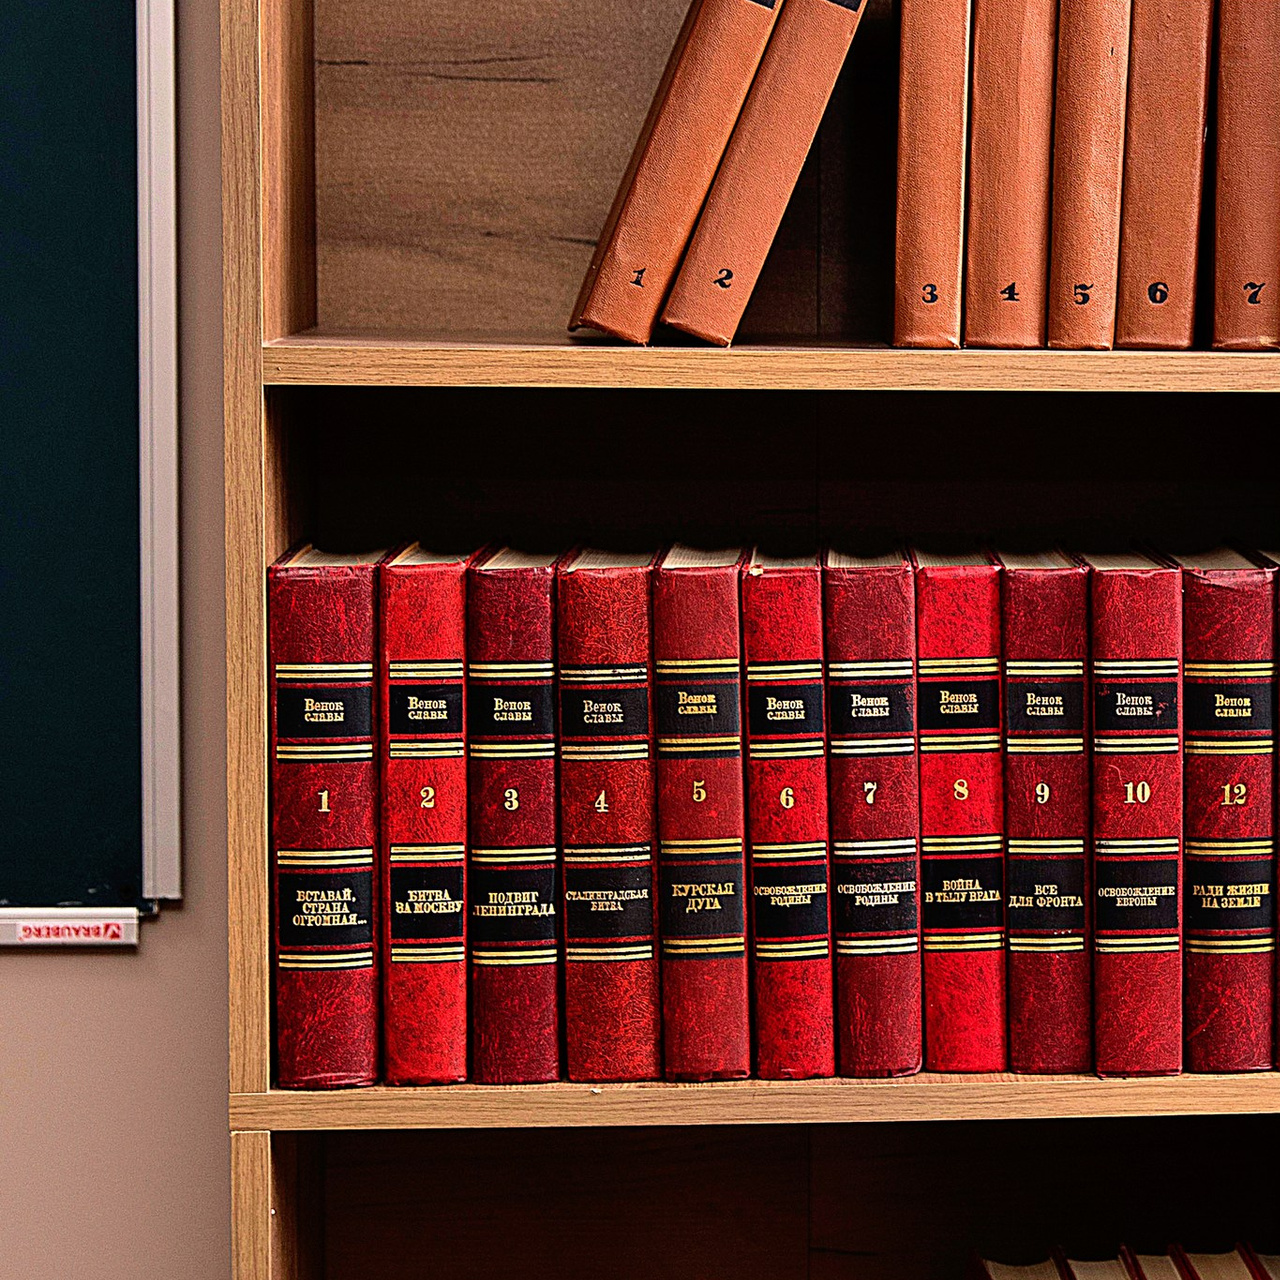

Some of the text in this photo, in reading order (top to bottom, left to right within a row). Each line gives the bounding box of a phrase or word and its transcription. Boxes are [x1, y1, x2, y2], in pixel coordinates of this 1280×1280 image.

[630, 267, 647, 288] 1
[713, 268, 734, 289] 2
[921, 283, 939, 304] 3
[1000, 281, 1020, 302] 4
[1073, 283, 1094, 305] 5
[1147, 281, 1170, 304] 6
[1243, 281, 1266, 304] 7
[305, 698, 344, 712] Венок
[408, 696, 447, 710] Венок
[494, 698, 532, 711] Венок
[305, 710, 344, 722] славы
[408, 709, 448, 720] славы
[692, 781, 707, 802] 5
[864, 782, 877, 804] 7
[953, 779, 968, 800] 8
[1035, 782, 1049, 804] 9
[1124, 781, 1150, 803] 10
[1221, 783, 1247, 806] 12
[317, 790, 331, 812] 1
[420, 787, 435, 808] 2
[504, 788, 519, 810] 3
[595, 790, 609, 812] 4
[780, 787, 794, 808] 6
[672, 882, 735, 897] КУРСКАЯ
[754, 883, 827, 895] ОСВОБОЖДЕНИЕ
[838, 881, 916, 894] ОСВОБОЖДЕНИЕ
[943, 879, 982, 891] ВОЙНА
[1035, 885, 1058, 895] ВСЕ
[1098, 886, 1175, 897] ОСВОБОЖДЕНИЕ
[1193, 883, 1270, 897] РАДИ ЖИЗНИ
[296, 888, 356, 902] ВСТАВАЙ,
[408, 889, 451, 902] БИТВА
[488, 891, 539, 905] ПОДВИГ
[565, 889, 648, 901] СТАЛИНГРАДСКАЯ
[771, 895, 811, 907] РОДИНЫ
[855, 894, 899, 906] РОДИНЫ
[925, 890, 1001, 903] В ТЫЛУ ВРАГА
[1009, 896, 1083, 908] ДЛЯ ФРОНТА
[1116, 897, 1157, 907] ЕВРОПЫ
[302, 902, 350, 914] СТРАНА
[395, 900, 464, 914] ЗА МОСКВУ
[591, 901, 624, 911] БИТВА
[686, 898, 722, 913] ДУГА
[1202, 897, 1261, 908] НА ЗЕМЛЕ
[473, 903, 555, 917] ЛЕНИНГРАДА
[22, 925, 101, 939] BRAUBERG
